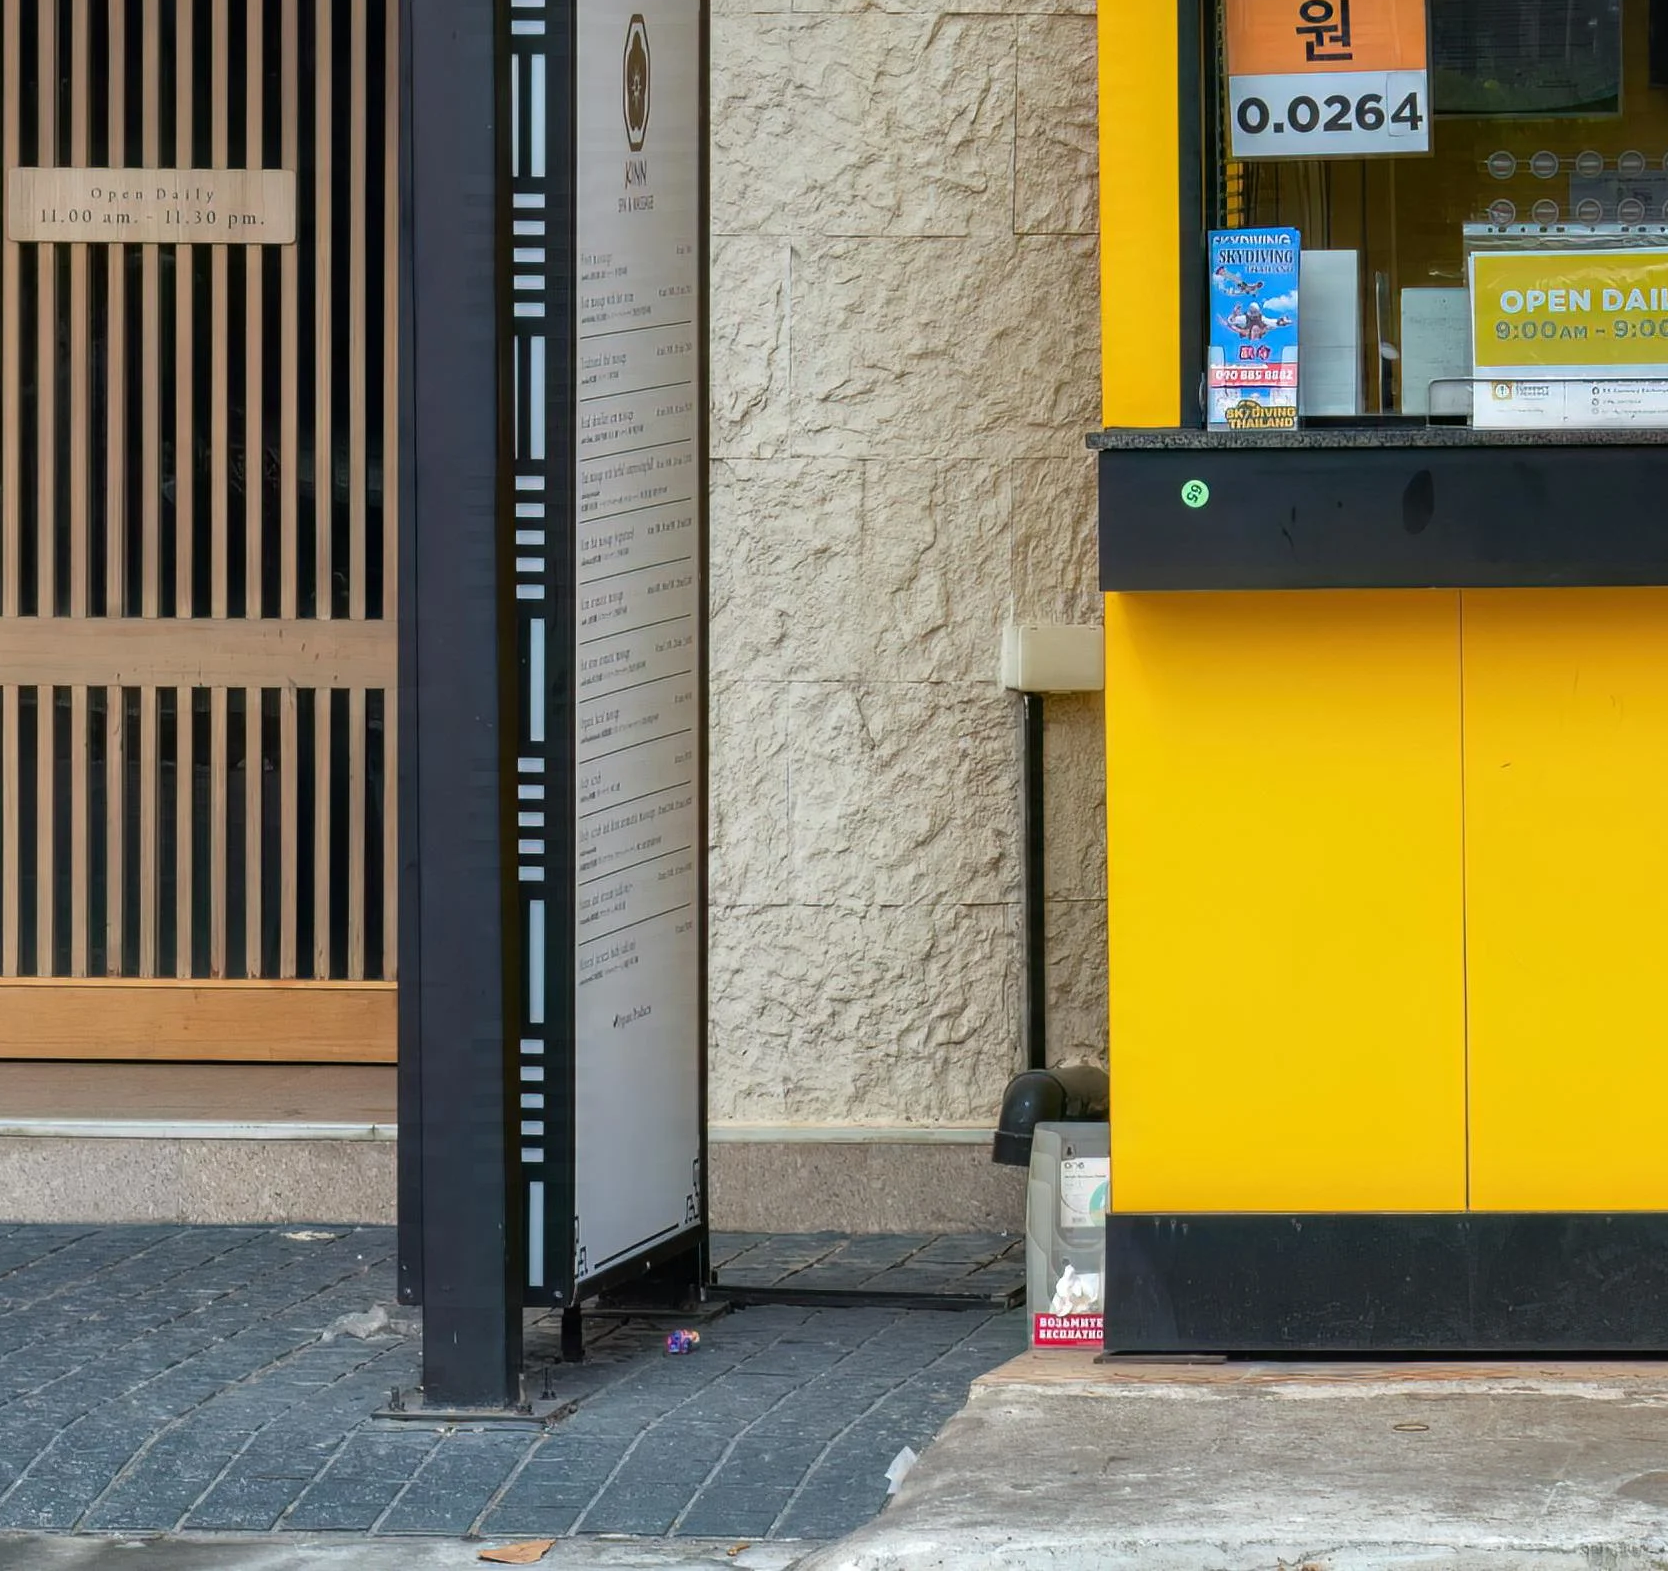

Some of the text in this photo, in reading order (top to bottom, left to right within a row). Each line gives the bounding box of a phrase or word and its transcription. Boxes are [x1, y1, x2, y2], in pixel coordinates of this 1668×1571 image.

[1236, 91, 1423, 134] 0.0264
[90, 186, 215, 204] Open Daily
[40, 209, 93, 224] 11.00
[165, 209, 217, 225] 11.30
[228, 212, 266, 230] pm.
[1219, 249, 1293, 264] SKYDIVING
[1499, 289, 1591, 314] OPEN
[1228, 417, 1294, 429] THAILAND
[1039, 1317, 1104, 1328] ВОЗЬМИТЕ
[1039, 1329, 1104, 1339] БЕСПЛАТНО
